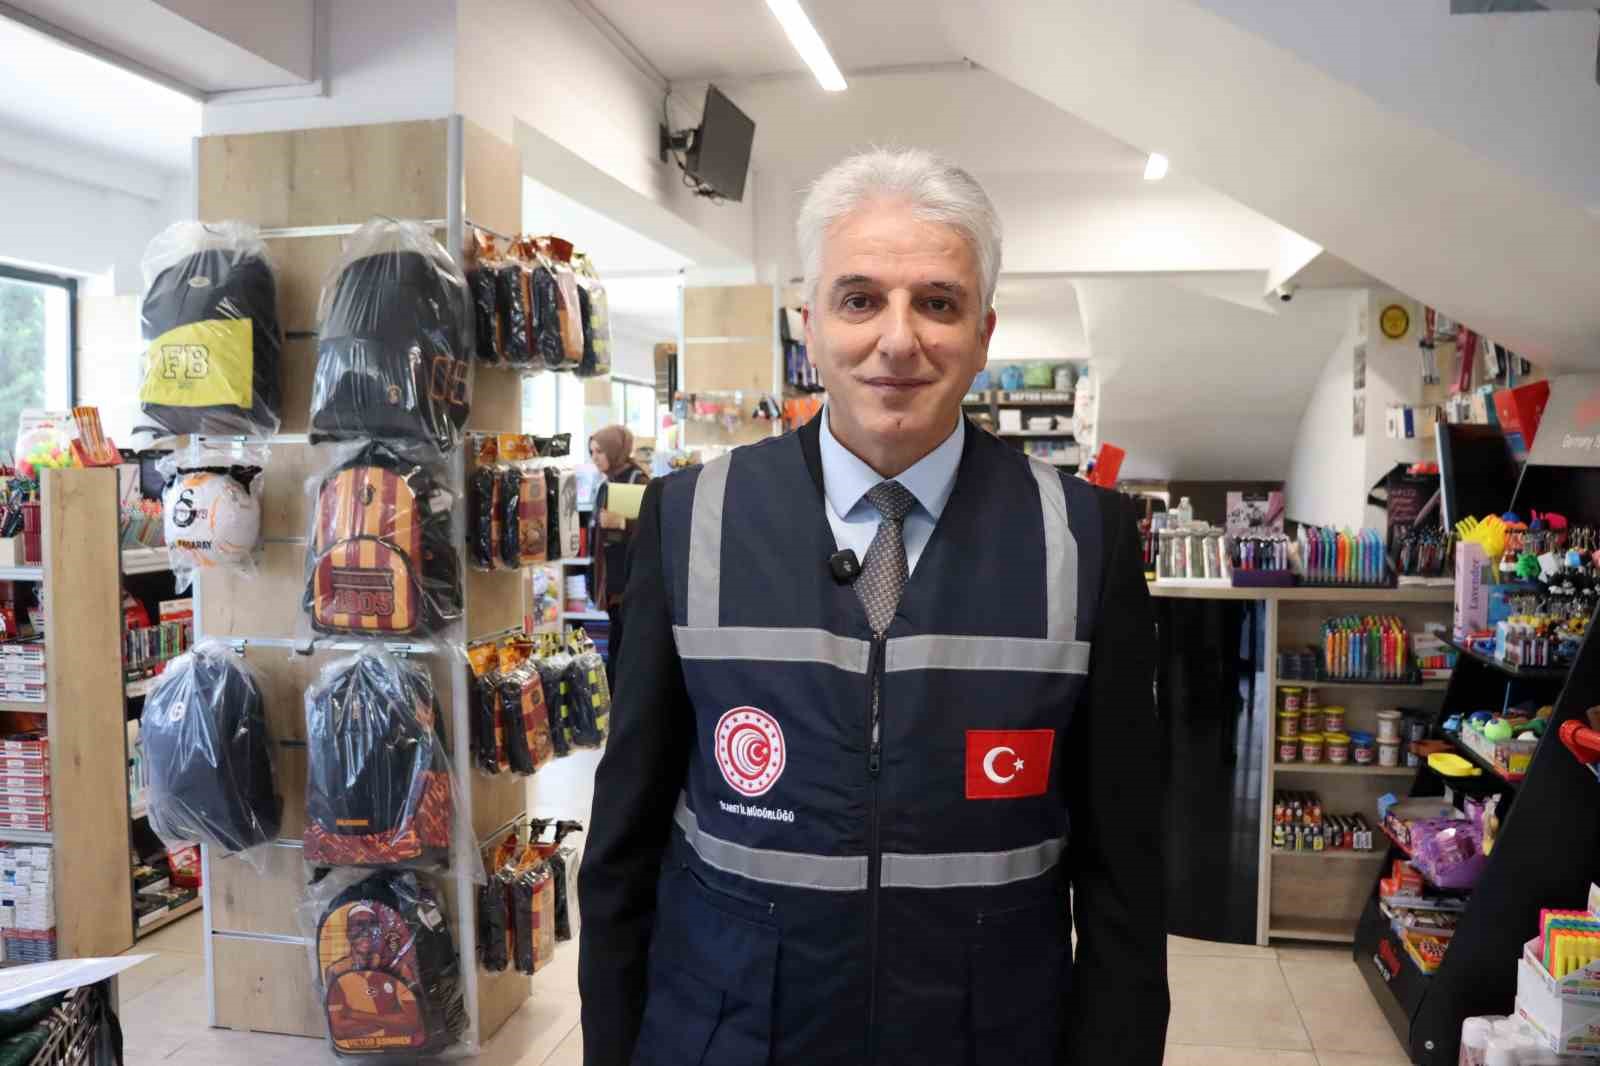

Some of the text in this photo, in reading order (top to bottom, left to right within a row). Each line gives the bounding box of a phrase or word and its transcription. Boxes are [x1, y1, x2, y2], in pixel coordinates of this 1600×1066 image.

[161, 344, 209, 379] FB
[1470, 559, 1480, 609] Lavender
[334, 590, 394, 616] 1905
[747, 805, 795, 823] MÜDÜRLÜĞÜ
